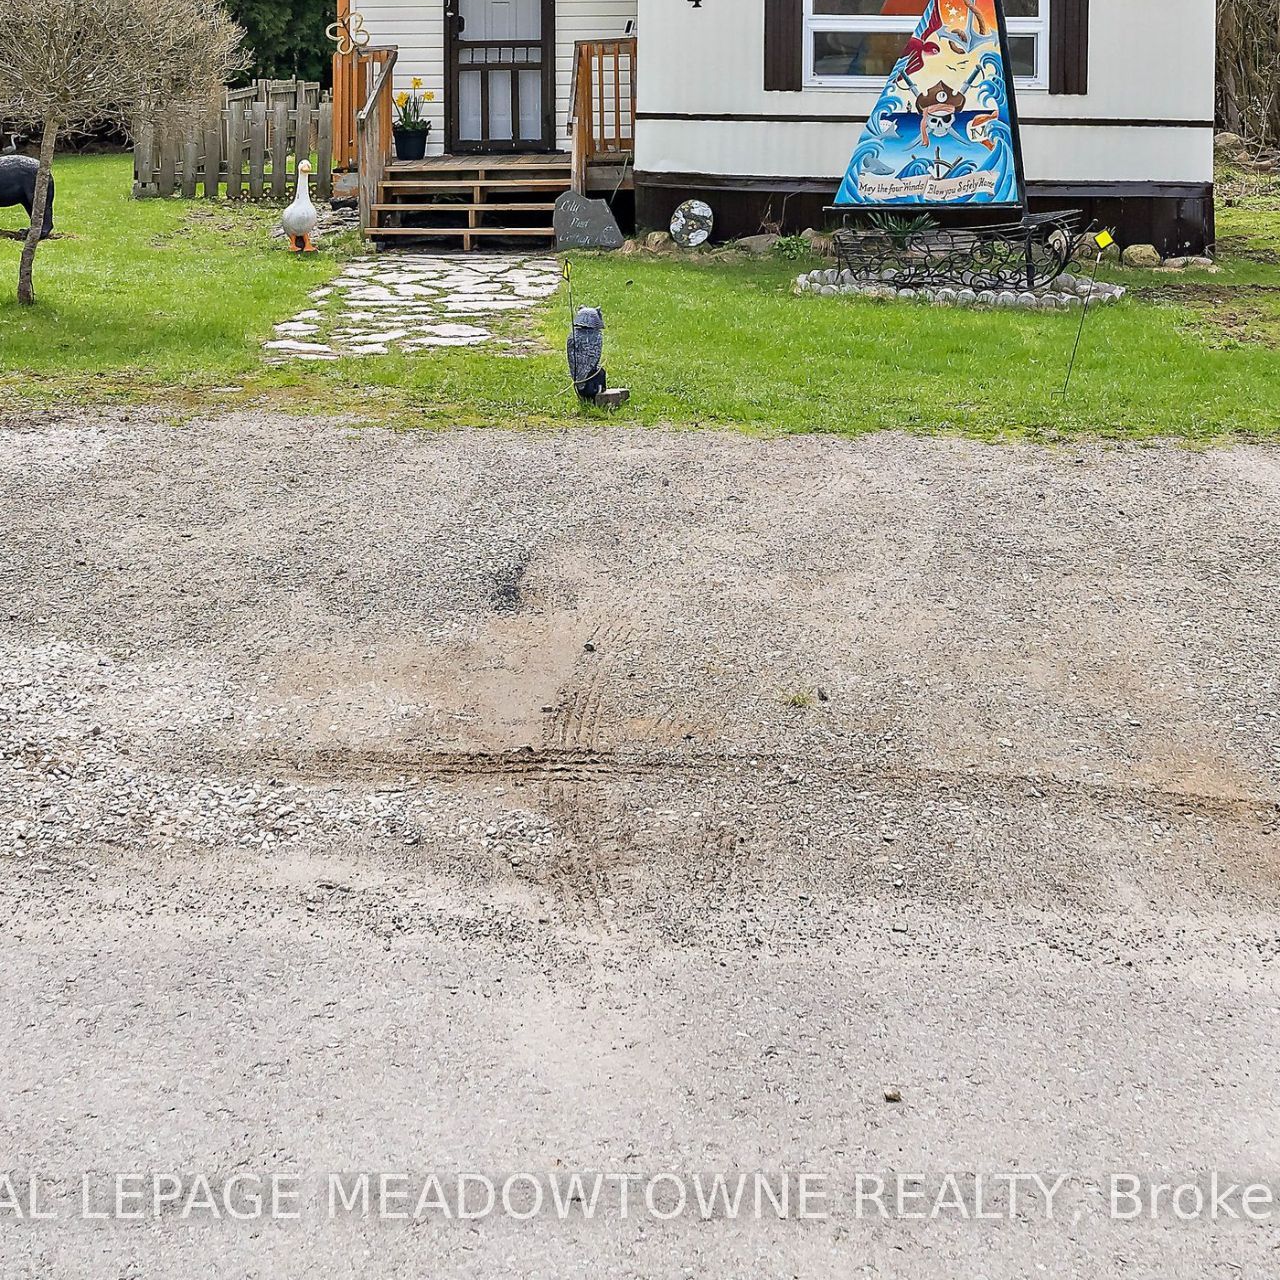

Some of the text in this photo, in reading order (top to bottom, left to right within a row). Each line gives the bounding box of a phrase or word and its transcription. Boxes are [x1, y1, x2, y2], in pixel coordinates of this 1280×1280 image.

[859, 180, 924, 195] May the four Winds
[927, 183, 945, 195] Blow
[941, 188, 956, 200] you
[979, 177, 995, 189] Home
